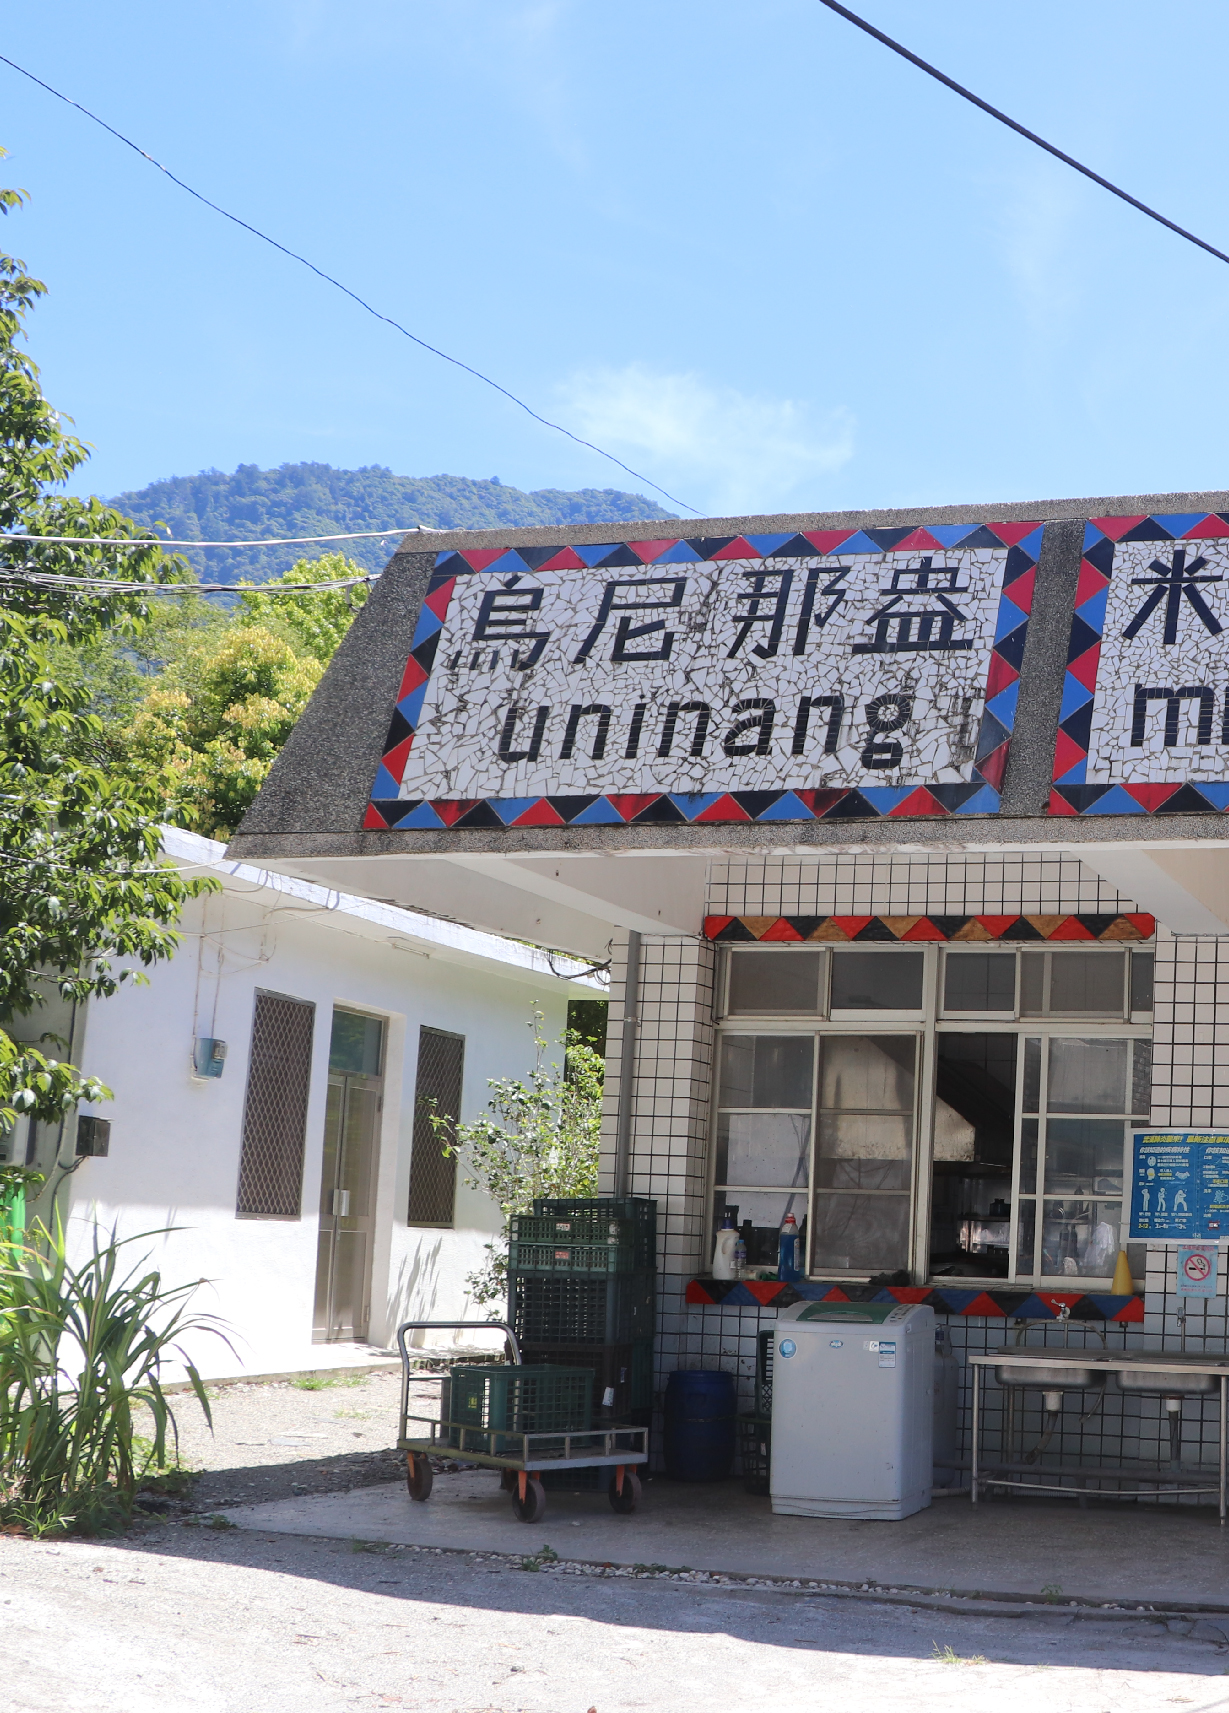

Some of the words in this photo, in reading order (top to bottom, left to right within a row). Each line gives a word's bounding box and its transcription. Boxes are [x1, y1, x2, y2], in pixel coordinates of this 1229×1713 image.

[450, 556, 973, 671] 烏尼那盎
[498, 693, 917, 770] uninang
